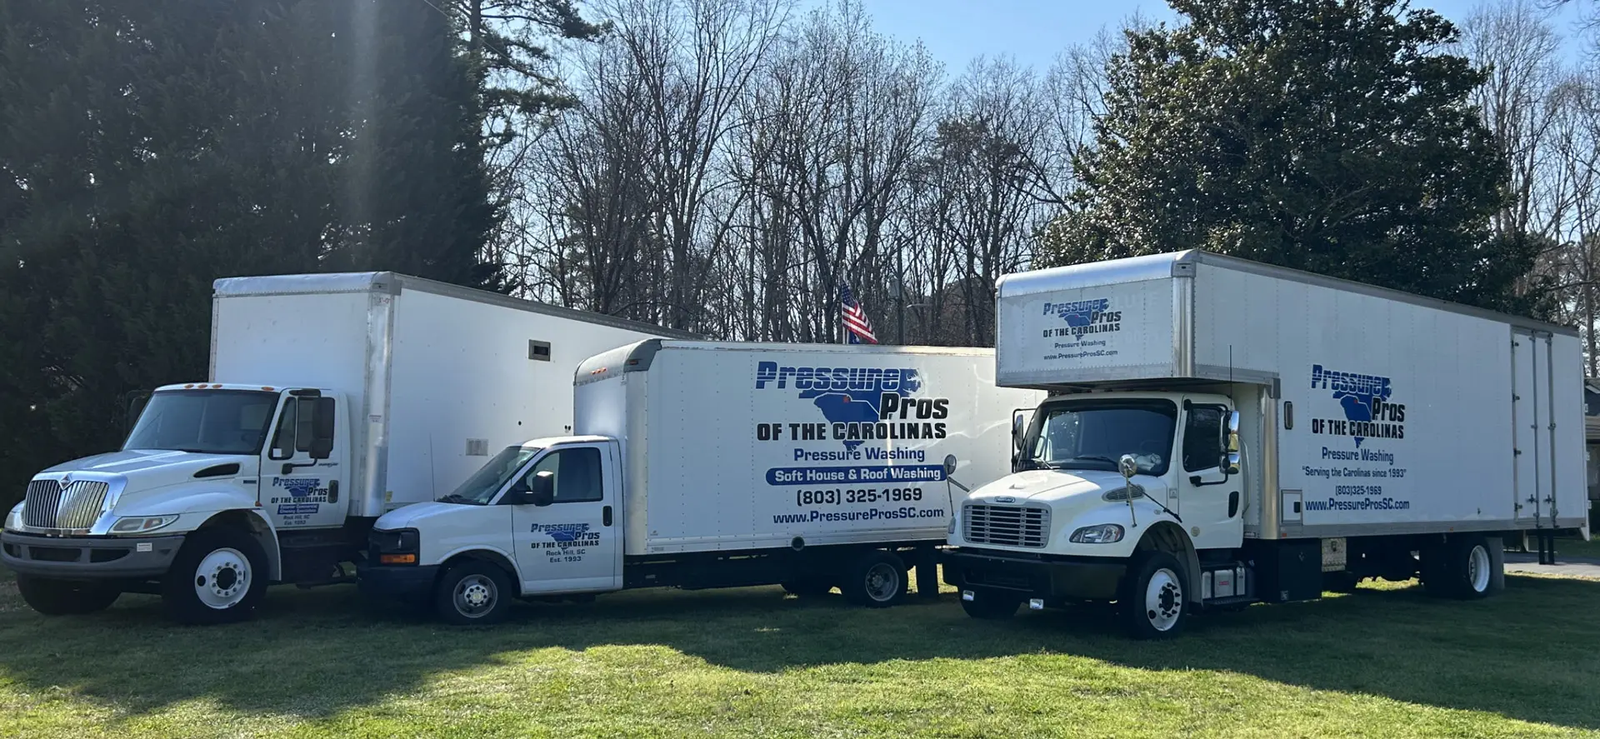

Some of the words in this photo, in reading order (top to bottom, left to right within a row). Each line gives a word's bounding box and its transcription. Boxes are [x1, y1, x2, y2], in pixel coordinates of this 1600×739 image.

[1043, 299, 1101, 315] Pressure
[1091, 311, 1121, 324] Pros
[1043, 329, 1052, 338] OF
[1055, 327, 1069, 336] THE
[1071, 323, 1120, 335] CAROLINAS
[1054, 341, 1079, 349] Pressure
[1043, 350, 1118, 360] www.PressureProsSC.com
[755, 361, 900, 390] Pressure
[1311, 364, 1382, 396] Pressure
[880, 393, 949, 420] Pros
[1372, 397, 1406, 423] Pros
[757, 423, 782, 441] OF
[789, 423, 826, 440] THE
[832, 422, 947, 441] CAROLINAS
[1312, 418, 1325, 434] OF
[1328, 420, 1347, 435] THE
[1349, 422, 1404, 440] CAROLINAS
[794, 448, 861, 462] Pressure
[865, 447, 925, 462] Washing
[1321, 446, 1359, 460] Pressure
[1360, 448, 1394, 465] Washing
[775, 469, 803, 482] Soft
[806, 469, 845, 481] House
[848, 469, 857, 480] &
[860, 468, 888, 480] Roof
[891, 466, 941, 481] Washing
[1331, 467, 1342, 477] the
[1343, 467, 1371, 477] Carolinas
[1372, 468, 1387, 477] since
[272, 477, 315, 487] Pressure
[308, 487, 328, 496] Pros
[797, 490, 841, 506] (803)
[846, 488, 922, 504] 325-1969
[1335, 485, 1382, 496] (803)325-1969
[1305, 498, 1410, 511] www.PressureProsSC.com
[773, 507, 944, 524] www.PressureProsSC.com
[530, 523, 583, 533] Pressure
[574, 531, 600, 540] Pros
[557, 540, 600, 548] CAROLINAS
